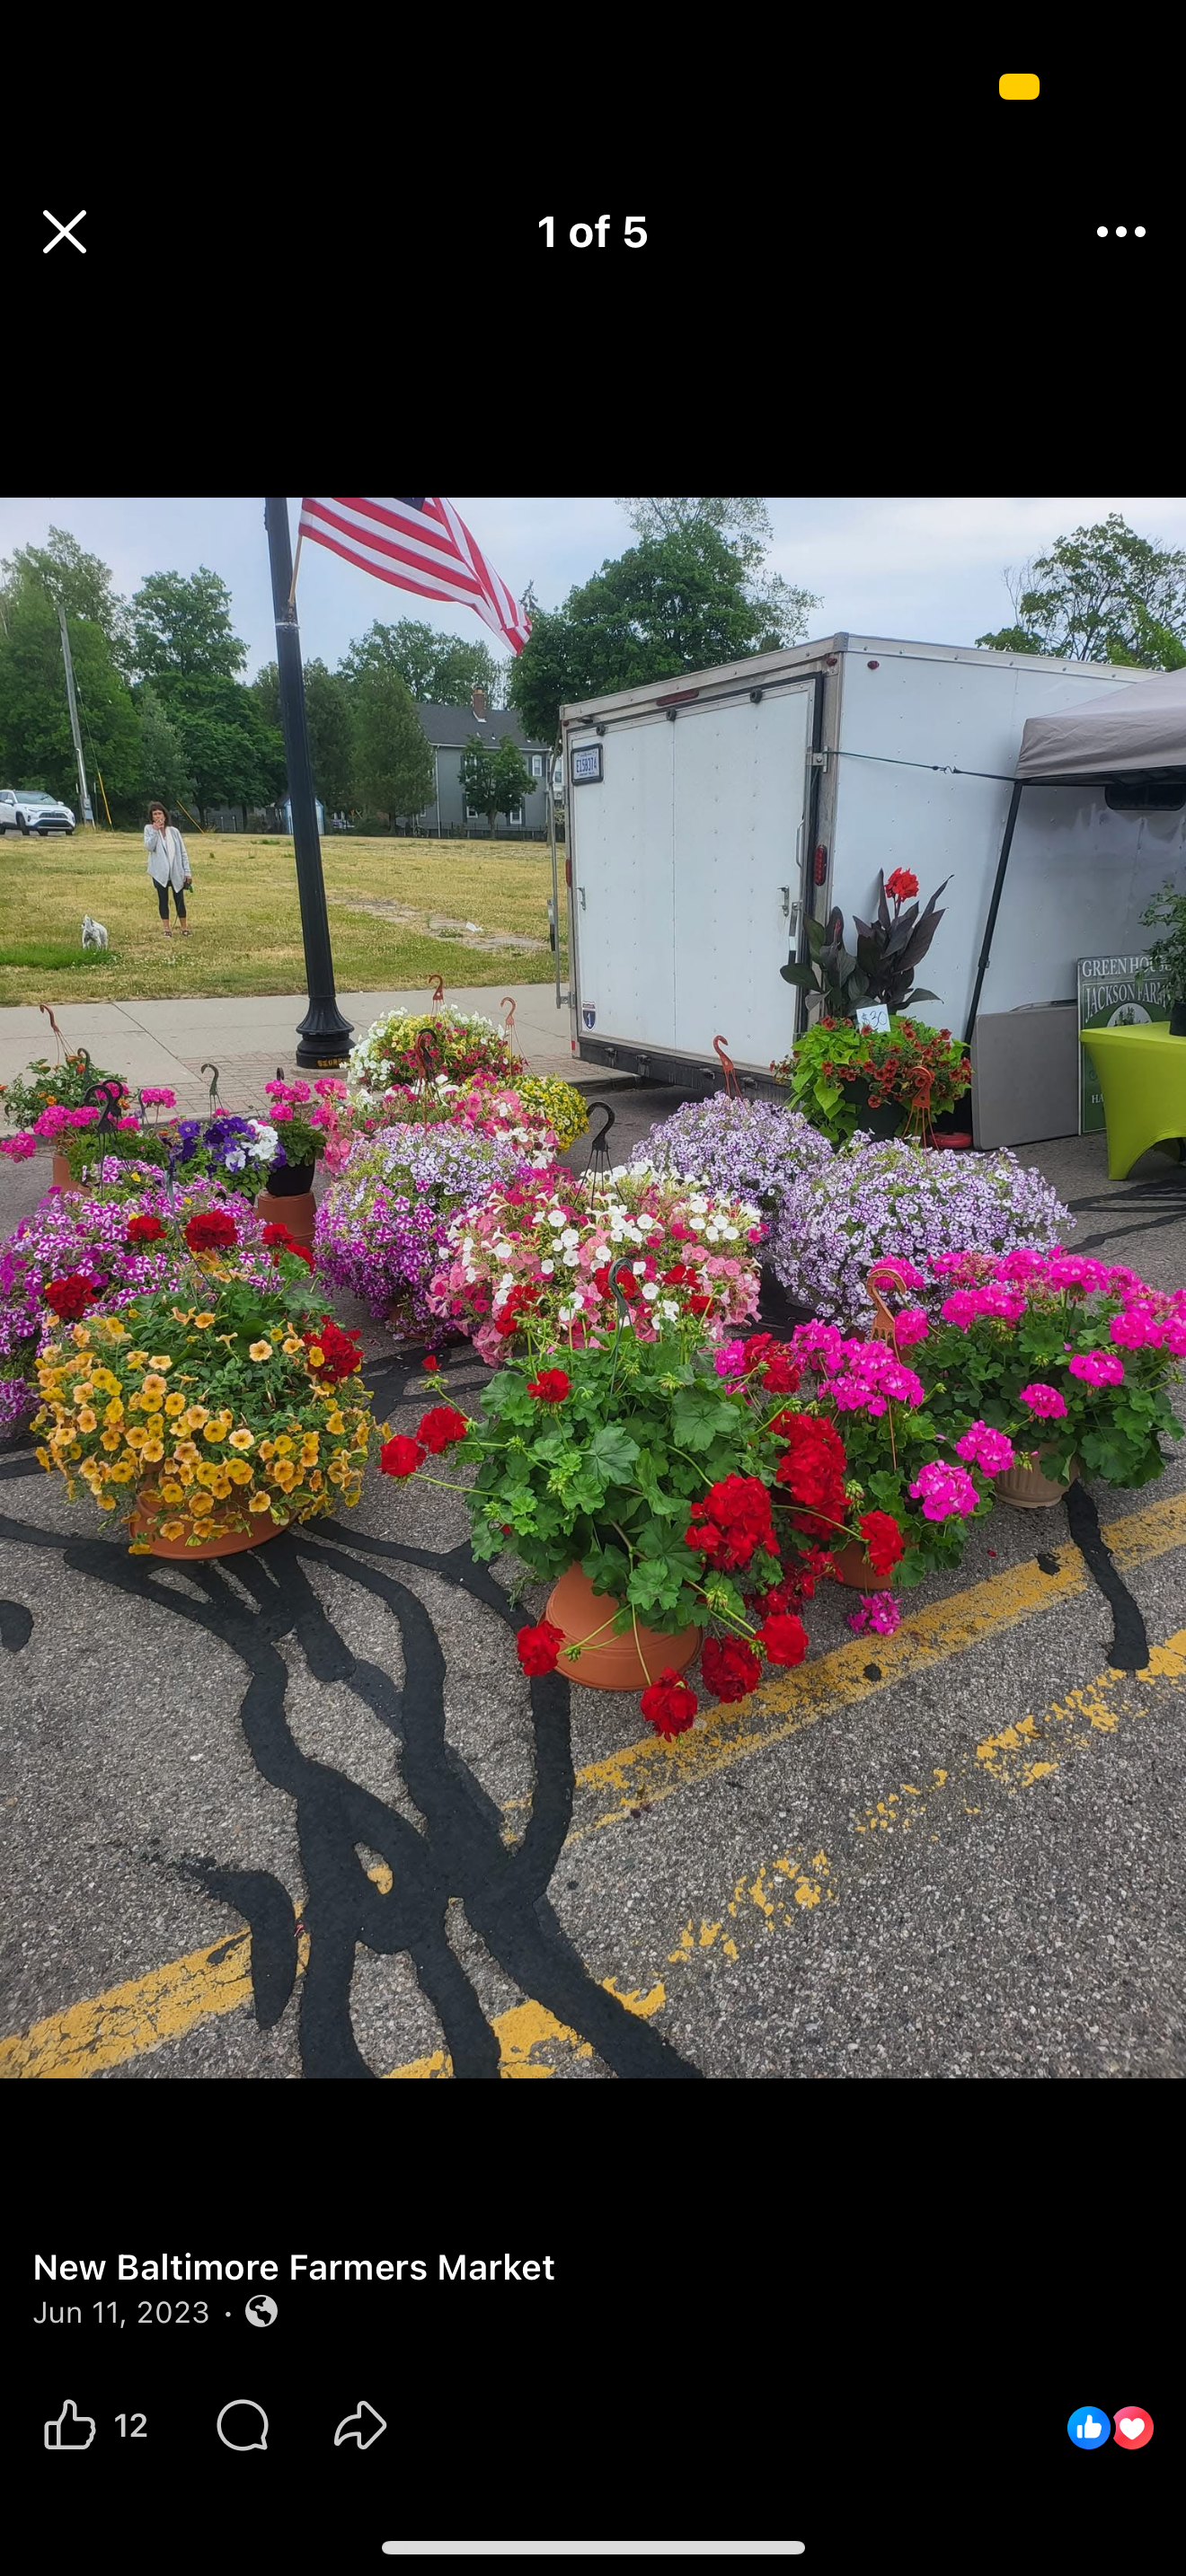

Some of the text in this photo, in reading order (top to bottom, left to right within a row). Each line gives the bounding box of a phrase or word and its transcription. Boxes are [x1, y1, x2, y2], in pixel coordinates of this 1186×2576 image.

[1082, 957, 1128, 977] GREEN
[1085, 984, 1136, 1024] JACKSON
[861, 1010, 887, 1028] $30
